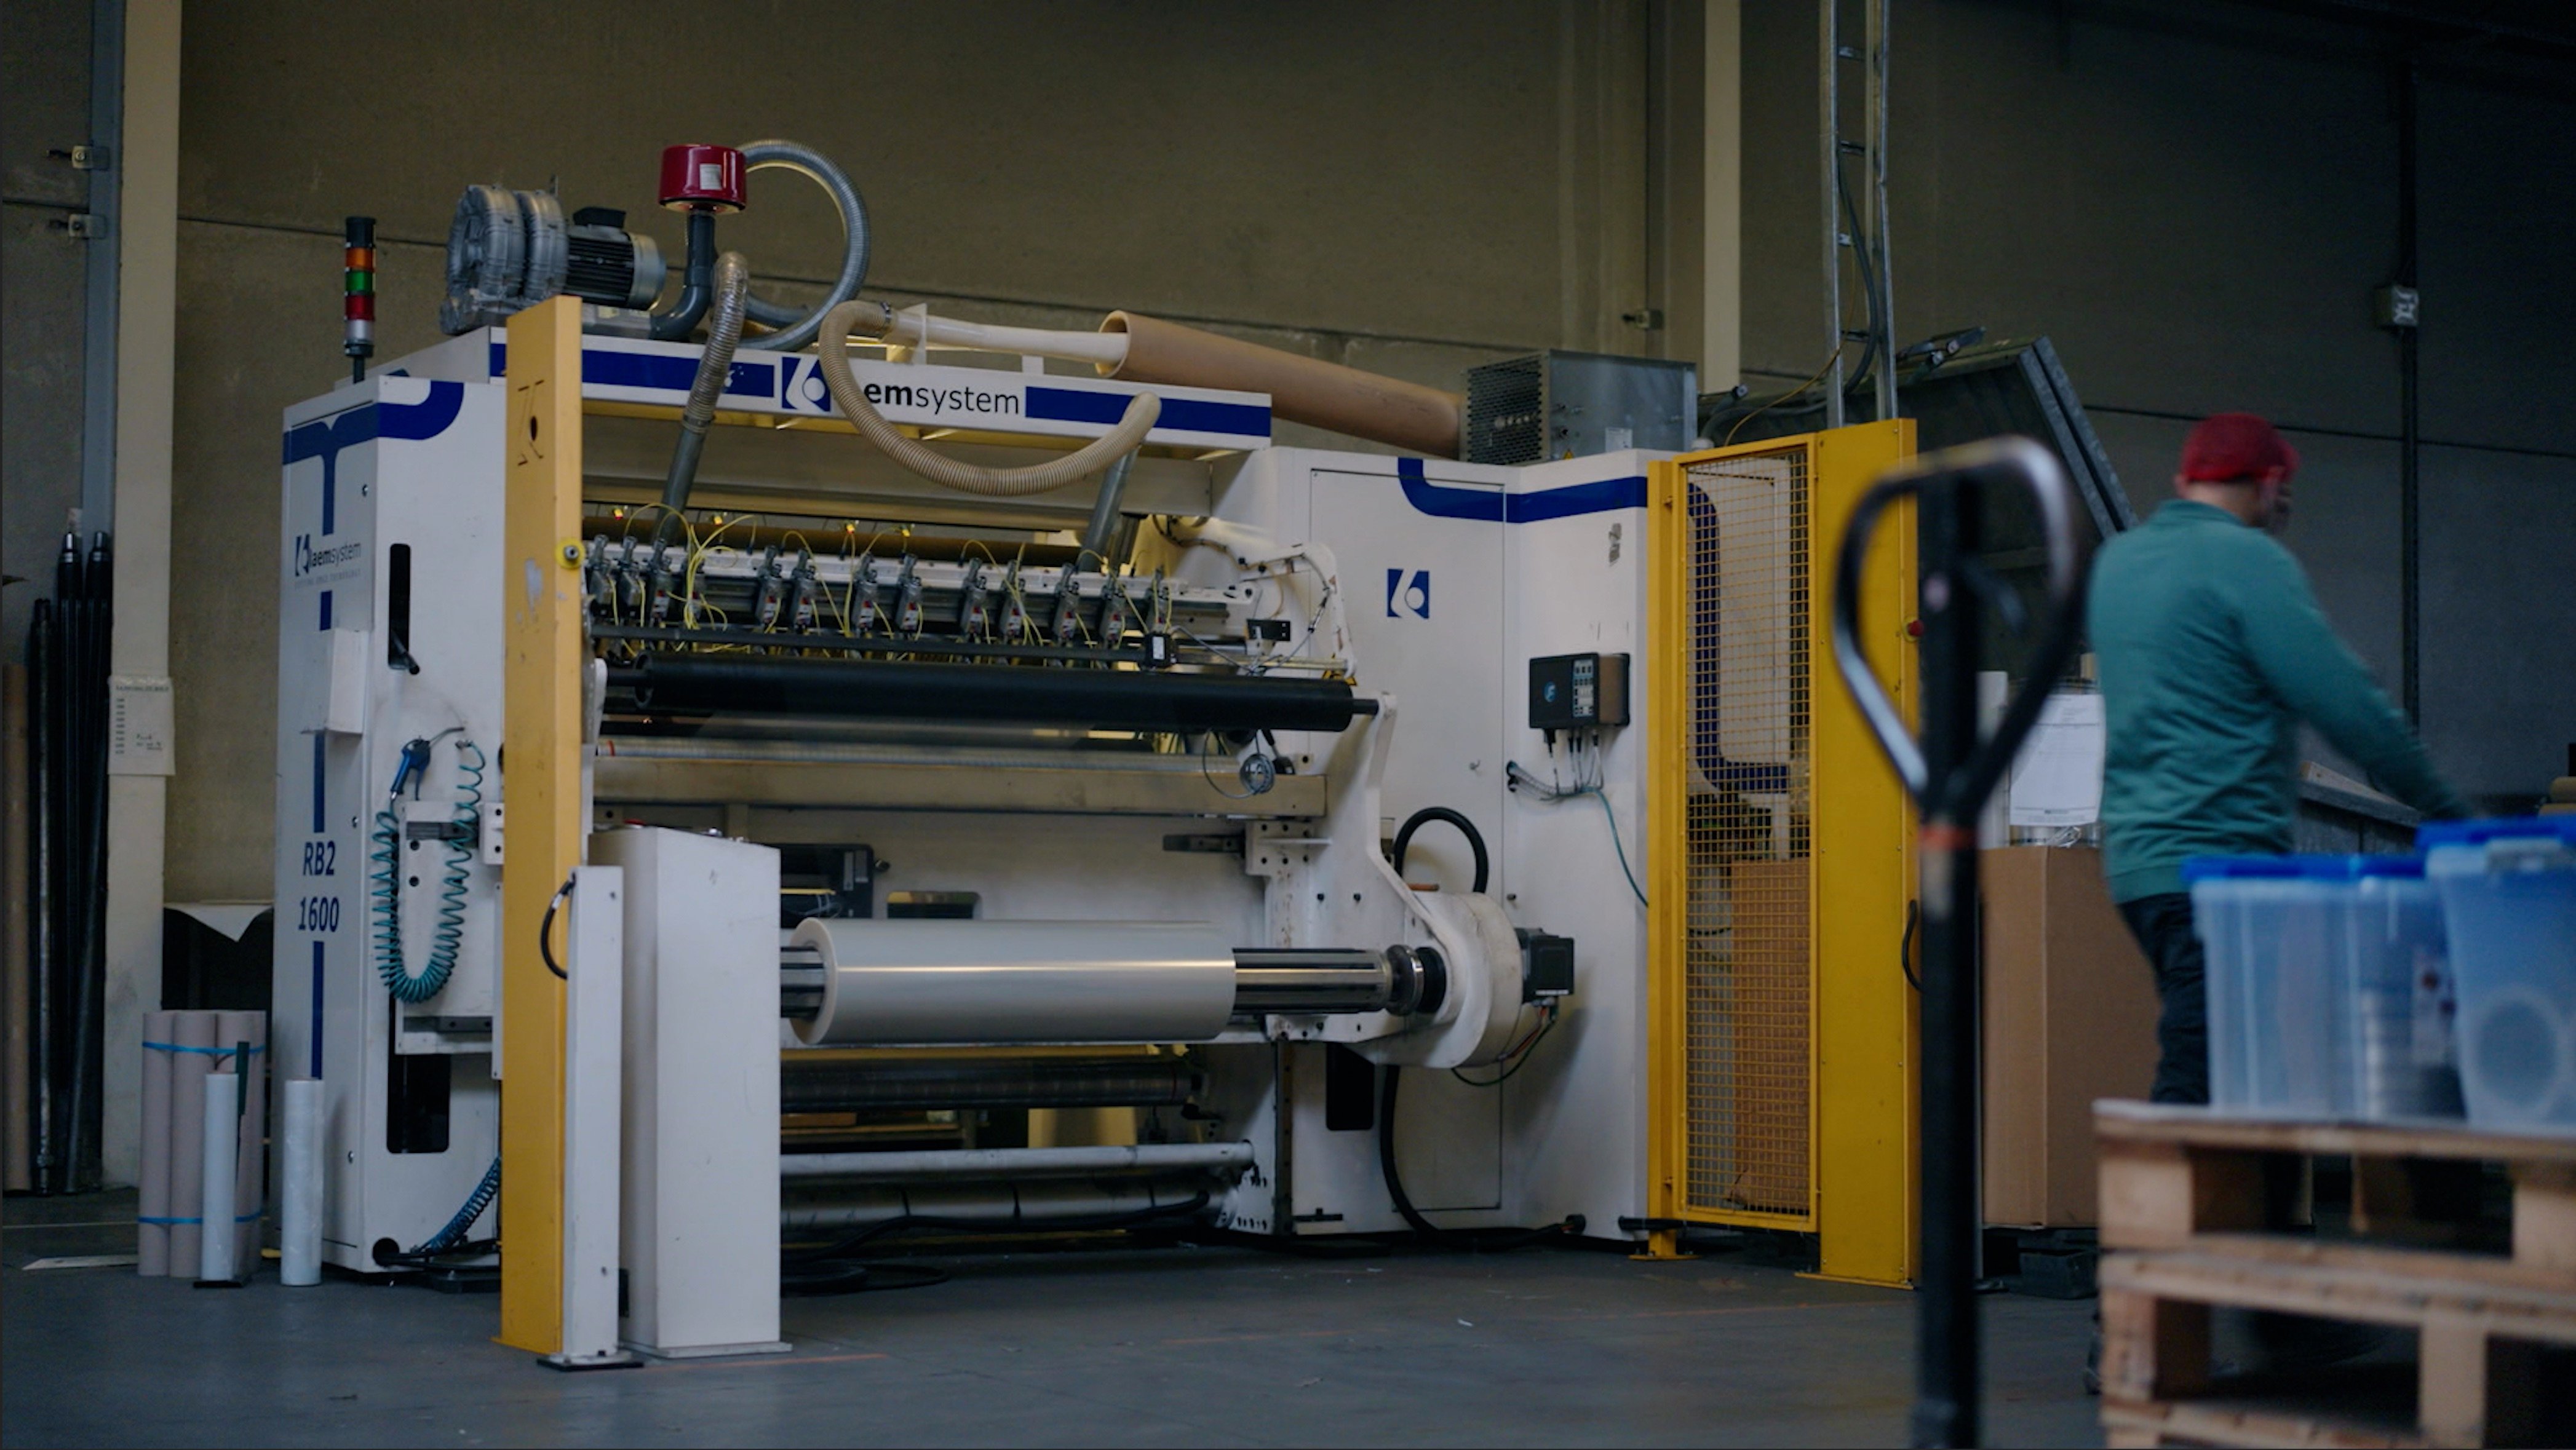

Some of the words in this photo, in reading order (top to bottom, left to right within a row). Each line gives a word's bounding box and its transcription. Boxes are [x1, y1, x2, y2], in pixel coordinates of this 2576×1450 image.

[864, 382, 1019, 415] emsystem
[303, 840, 335, 876] RB2
[298, 896, 340, 932] 1600
